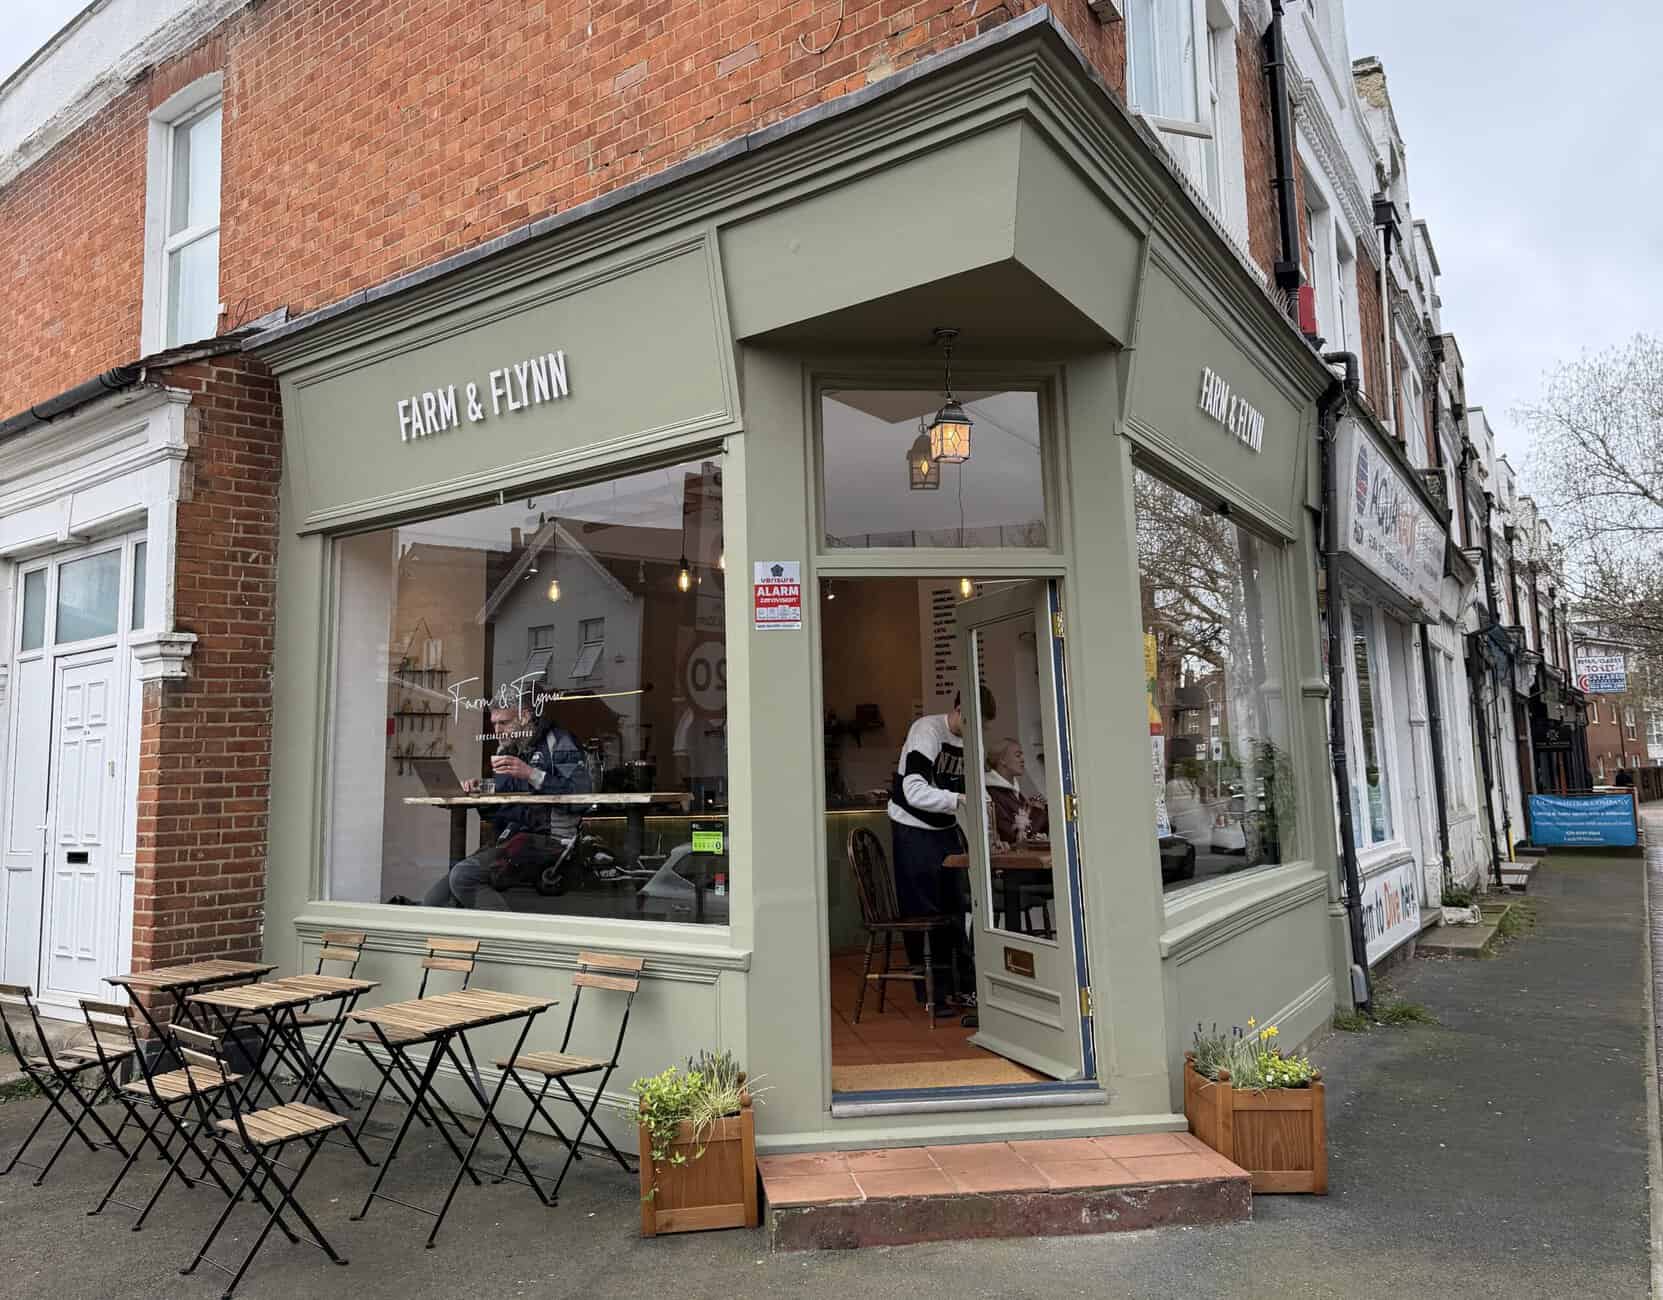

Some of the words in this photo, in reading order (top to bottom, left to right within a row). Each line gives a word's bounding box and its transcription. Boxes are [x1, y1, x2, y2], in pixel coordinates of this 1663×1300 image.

[398, 383, 460, 441] FARM
[465, 381, 484, 422] &
[489, 350, 569, 415] FLYNN
[1200, 366, 1230, 424] FARM
[1228, 395, 1238, 432] &
[1237, 398, 1265, 453] FLYNN
[757, 586, 799, 596] ALARM
[447, 676, 492, 727] Farm
[500, 683, 511, 709] &
[510, 670, 564, 722] Flynn
[510, 730, 533, 739] COFFEE
